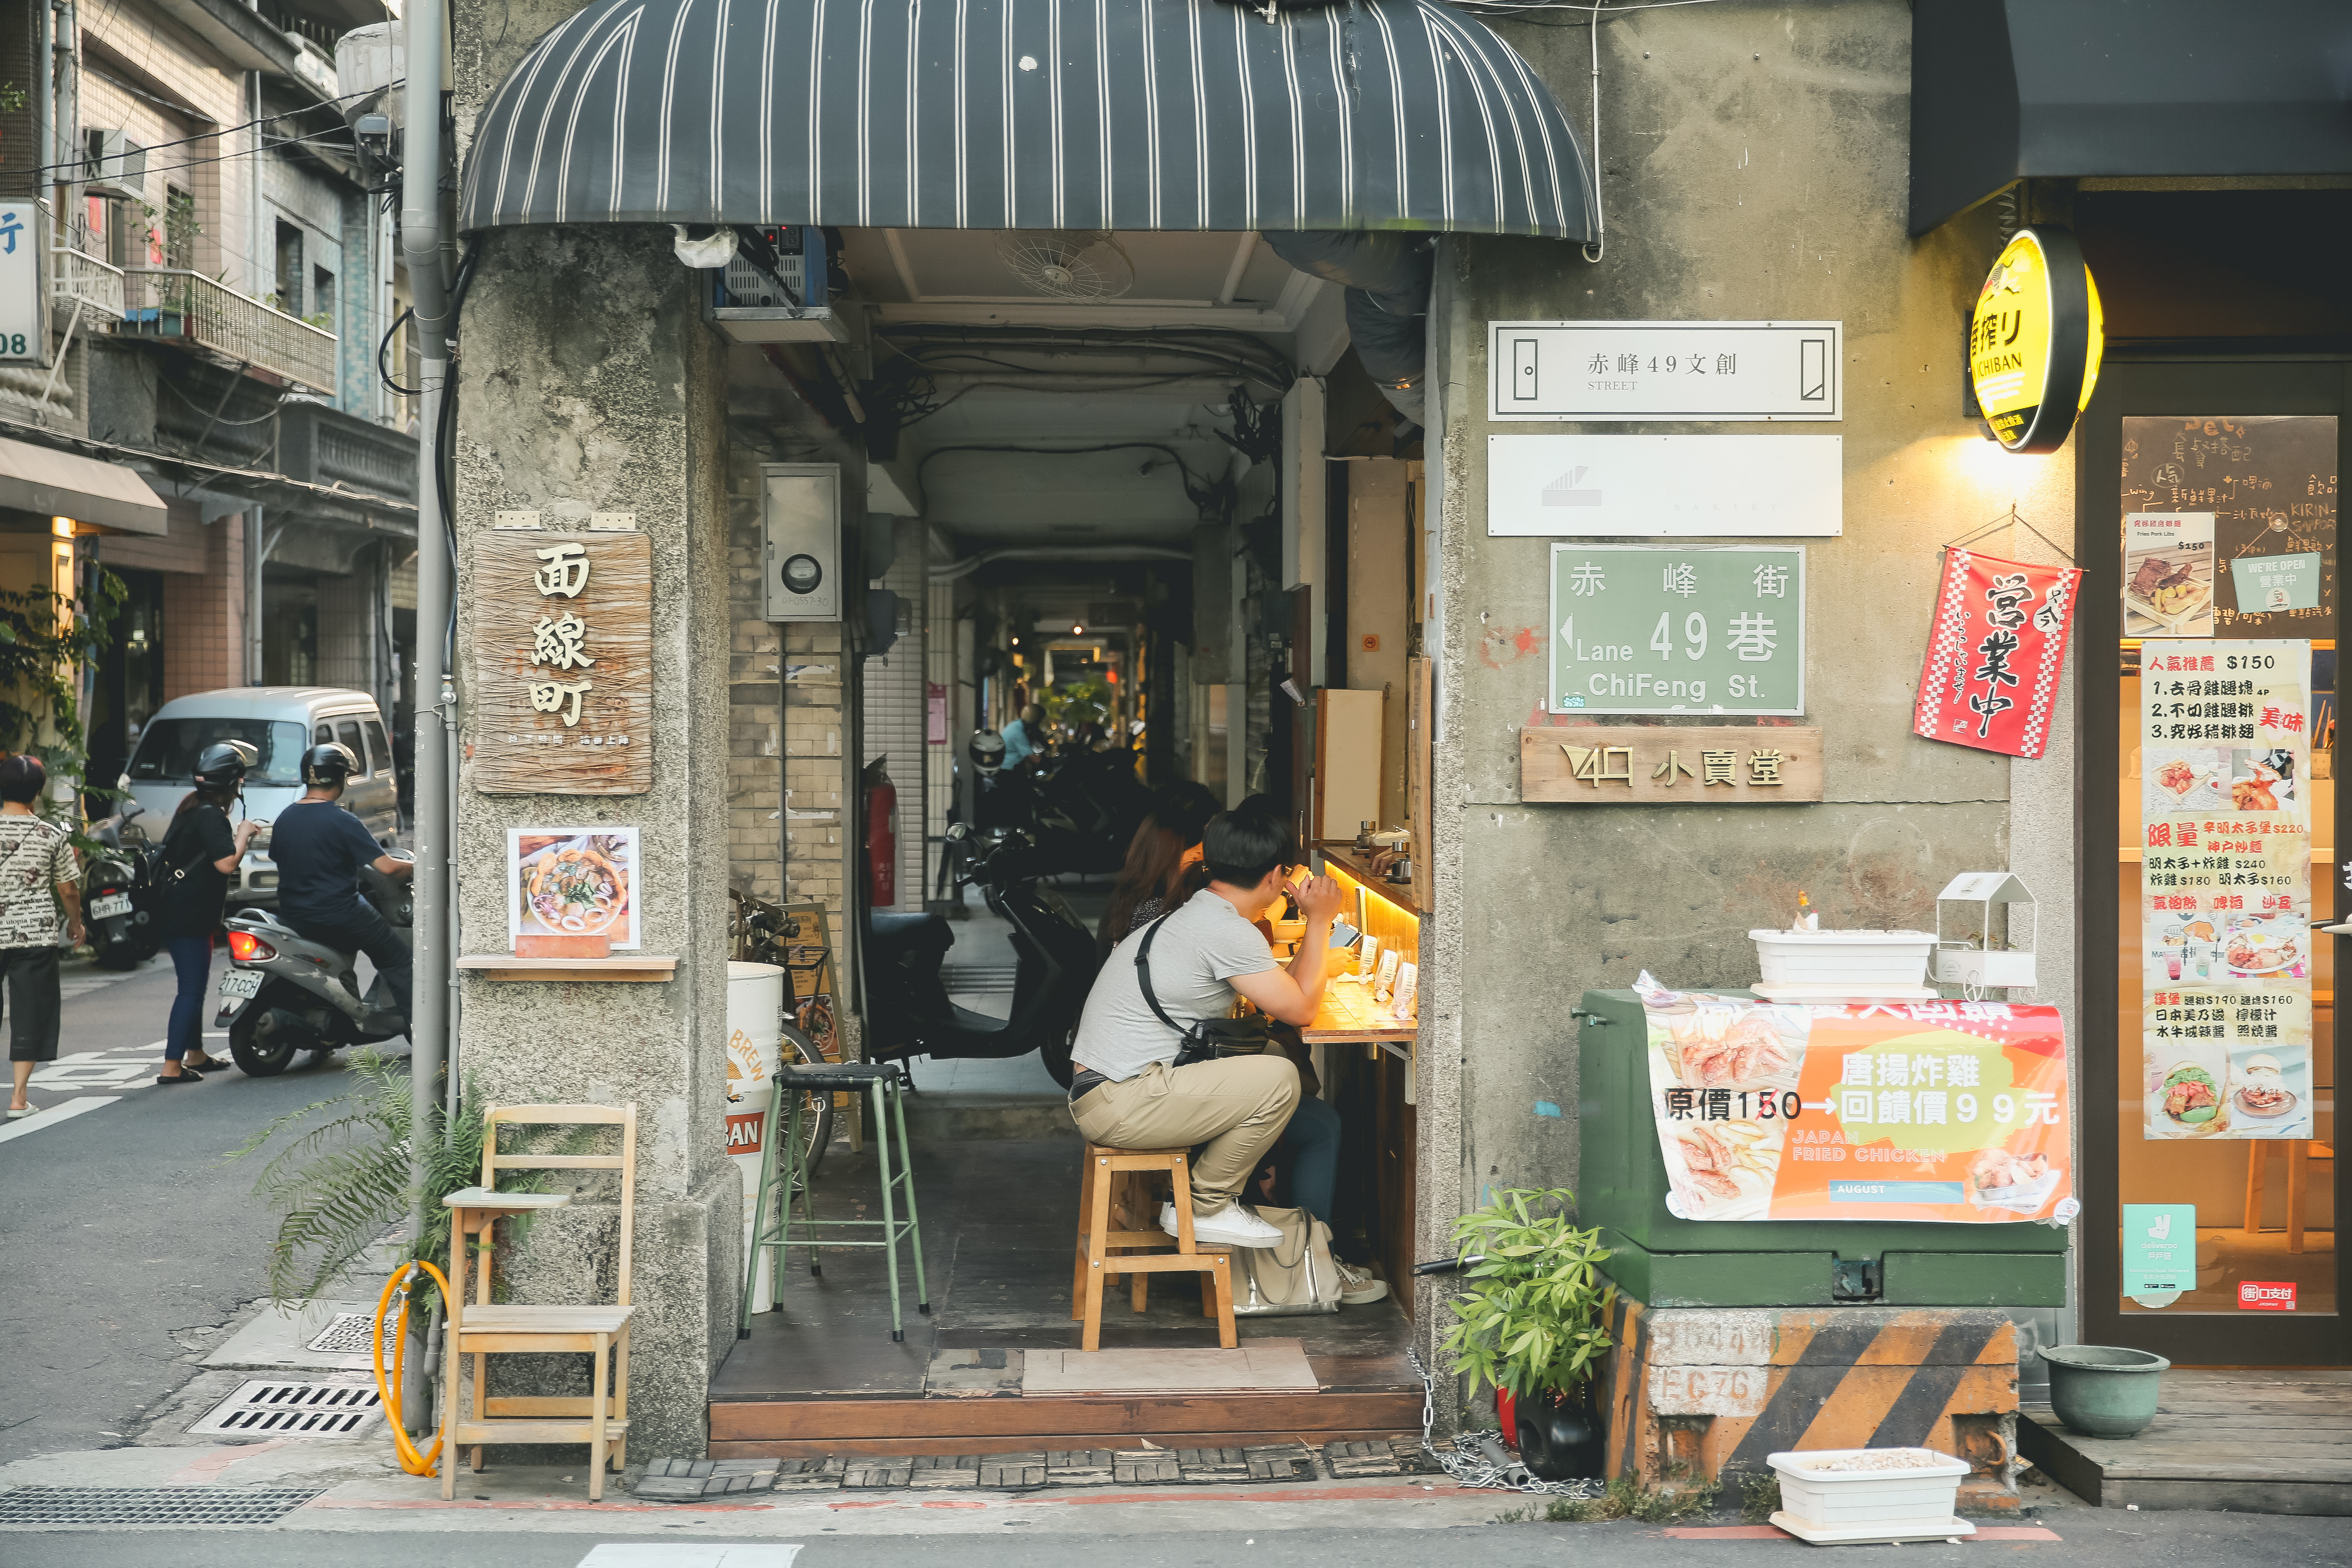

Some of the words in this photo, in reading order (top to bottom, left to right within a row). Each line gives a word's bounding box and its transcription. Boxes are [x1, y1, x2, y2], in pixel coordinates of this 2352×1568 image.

[1587, 353, 1737, 375] 赤峰49文創
[1977, 352, 2022, 378] ICHIBAN
[1588, 381, 1637, 391] STREET
[1674, 503, 1778, 512] BAKERY
[2291, 503, 2329, 517] KIRIN
[2178, 541, 2205, 551] $150
[2248, 561, 2278, 573] WE'RE
[2280, 559, 2306, 571] OPEN
[1570, 561, 1789, 599] 赤峰街
[529, 543, 597, 727] 面線町
[1650, 611, 1778, 662] 49巷
[1576, 639, 1634, 662] Lane
[2149, 656, 2215, 672] 人氣推薦
[2227, 655, 2275, 670] $150
[1588, 673, 1706, 703] ChiFeng
[1728, 674, 1766, 699] St.
[2258, 706, 2303, 733] 美味
[1652, 748, 1785, 787] 小賣堂
[2148, 822, 2198, 848] 限量
[2149, 857, 2230, 870] 明太子+炸雞
[2214, 895, 2244, 910] 啤酒
[2156, 1009, 2225, 1022] 日本美乃滋
[728, 1028, 765, 1082] BREW
[1841, 1053, 1980, 1087] 唐揚炸雞
[726, 1121, 758, 1146] AN
[1792, 1130, 1859, 1145] JAPAN
[1793, 1147, 1846, 1161] FRIED
[1855, 1148, 1945, 1163] CHICKEN
[1837, 1185, 1885, 1194] AUGUST
[2242, 1285, 2292, 1301] 街口支付
